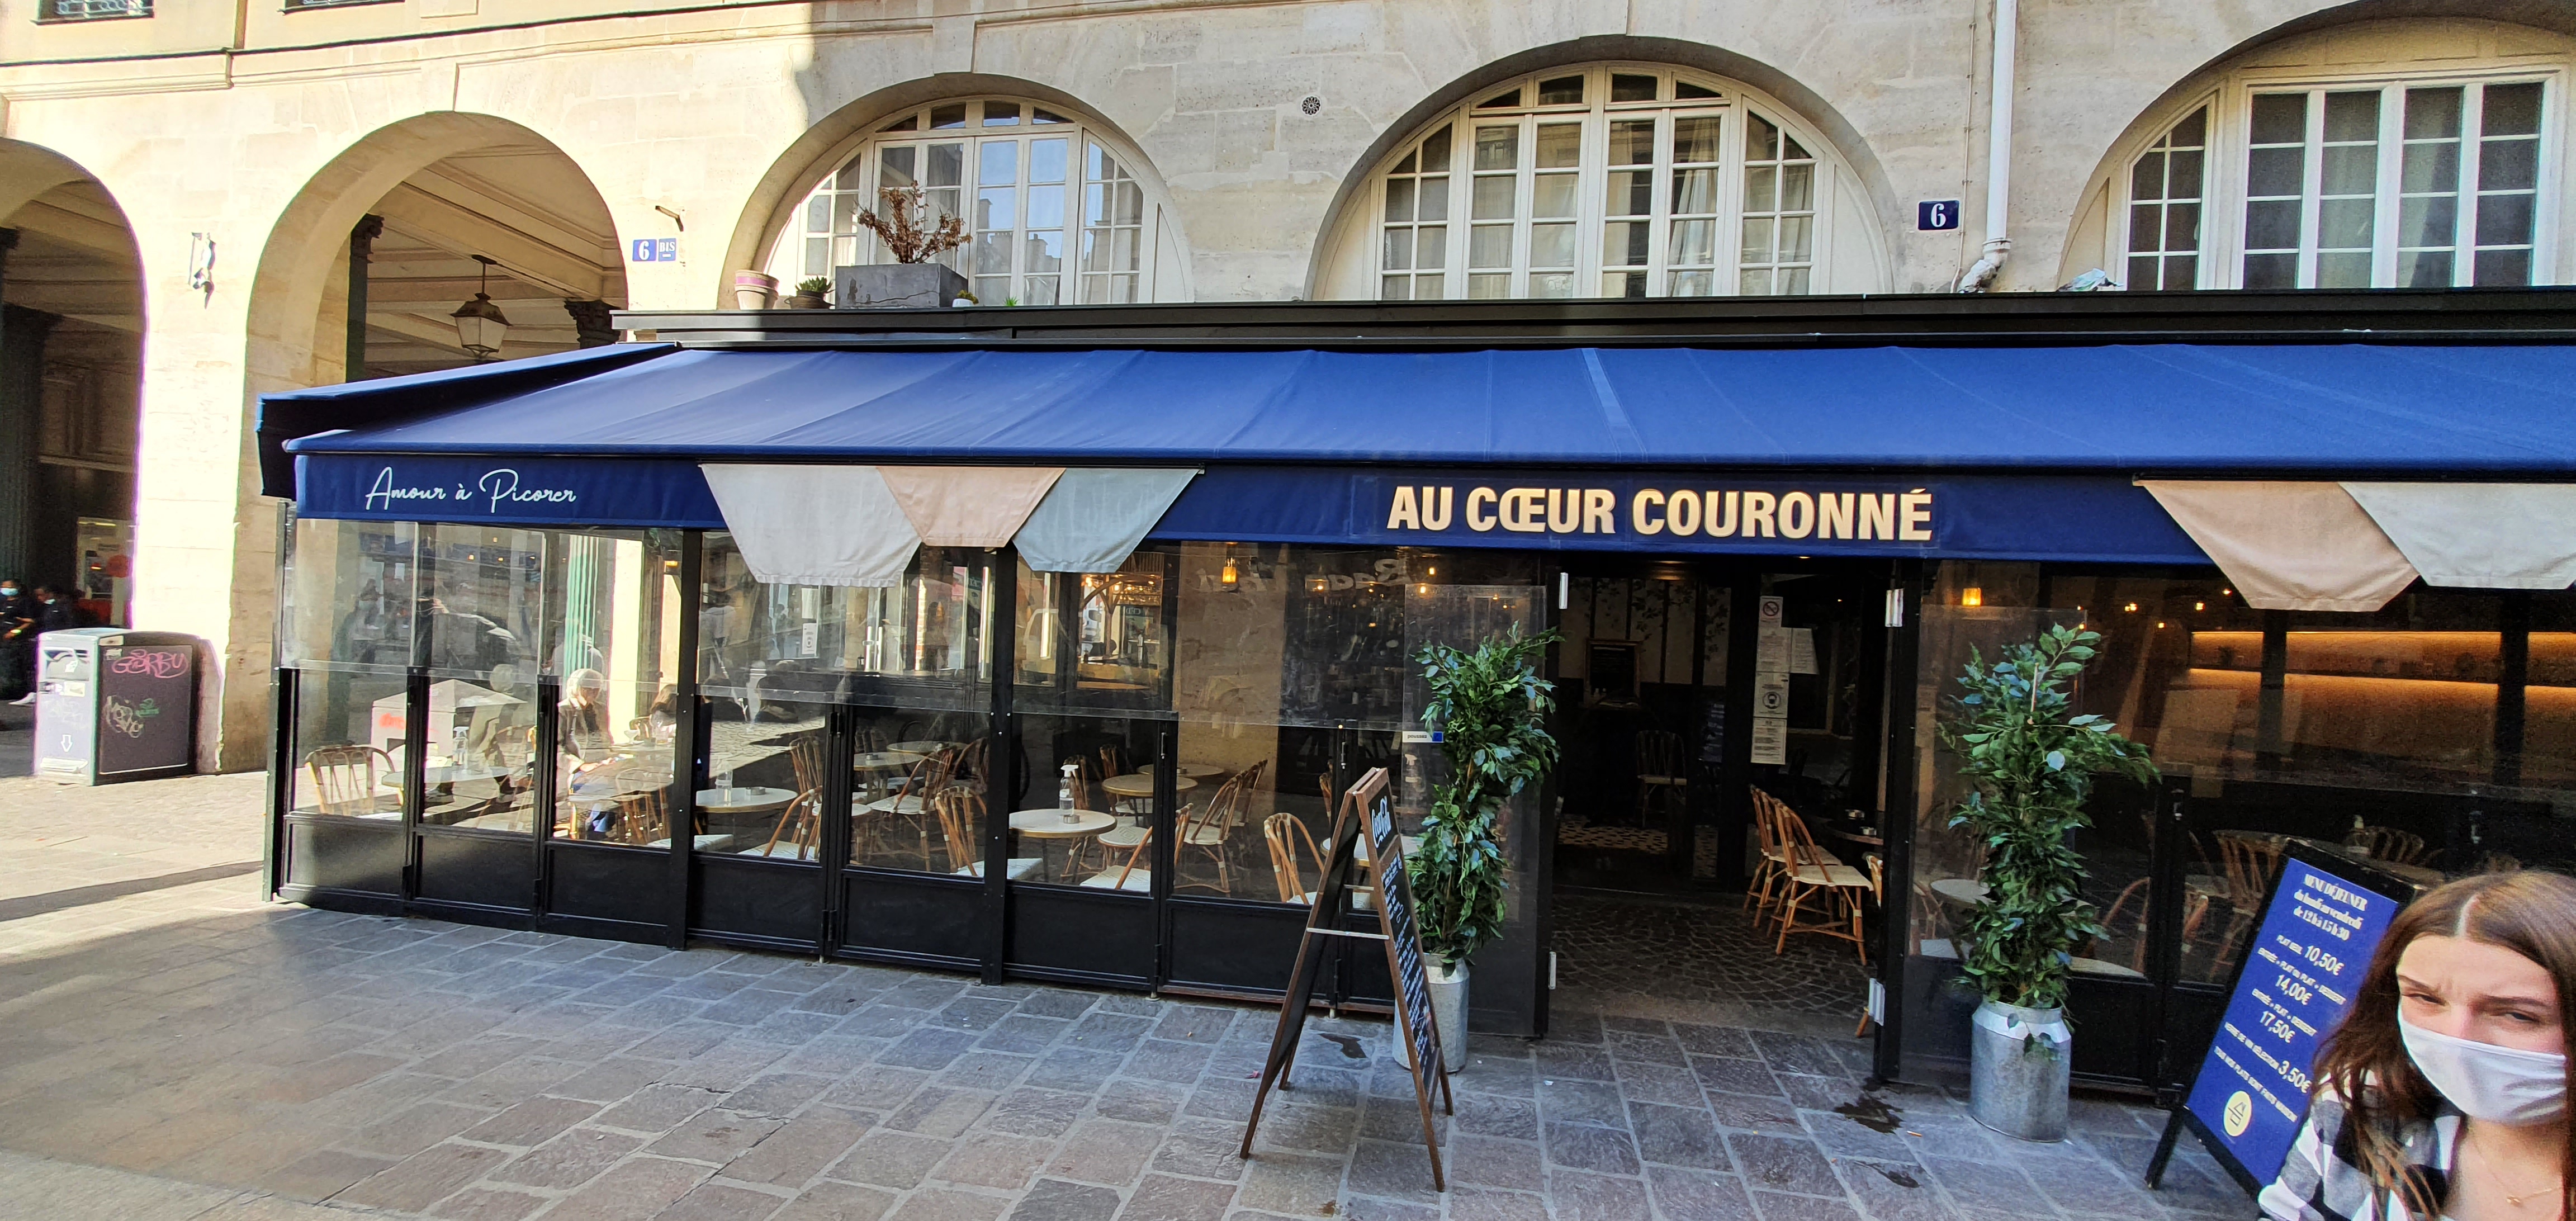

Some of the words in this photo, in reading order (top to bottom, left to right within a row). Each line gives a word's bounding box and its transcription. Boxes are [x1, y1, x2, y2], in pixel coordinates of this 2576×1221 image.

[1930, 203, 1946, 228] 6
[638, 240, 650, 260] 6
[659, 242, 675, 252] BIS
[365, 466, 446, 510] Amour
[454, 483, 472, 501] à
[479, 468, 576, 513] Picorer
[1386, 485, 1453, 531] AU
[1465, 486, 1616, 534] CŒUR
[1632, 488, 1933, 541] COURONNÉ
[2304, 873, 2327, 892] MENU
[2323, 883, 2368, 911] DÉJEUNER
[2276, 935, 2291, 946] PLAT
[2304, 945, 2345, 976] 10,50€
[2275, 974, 2312, 1005] 14,00€
[2280, 961, 2295, 973] PLAT
[2300, 973, 2316, 986] PLAT
[2274, 1004, 2289, 1016] PLAT
[2260, 1011, 2295, 1043] 17,50€
[2278, 1060, 2312, 1093] 3,50€
